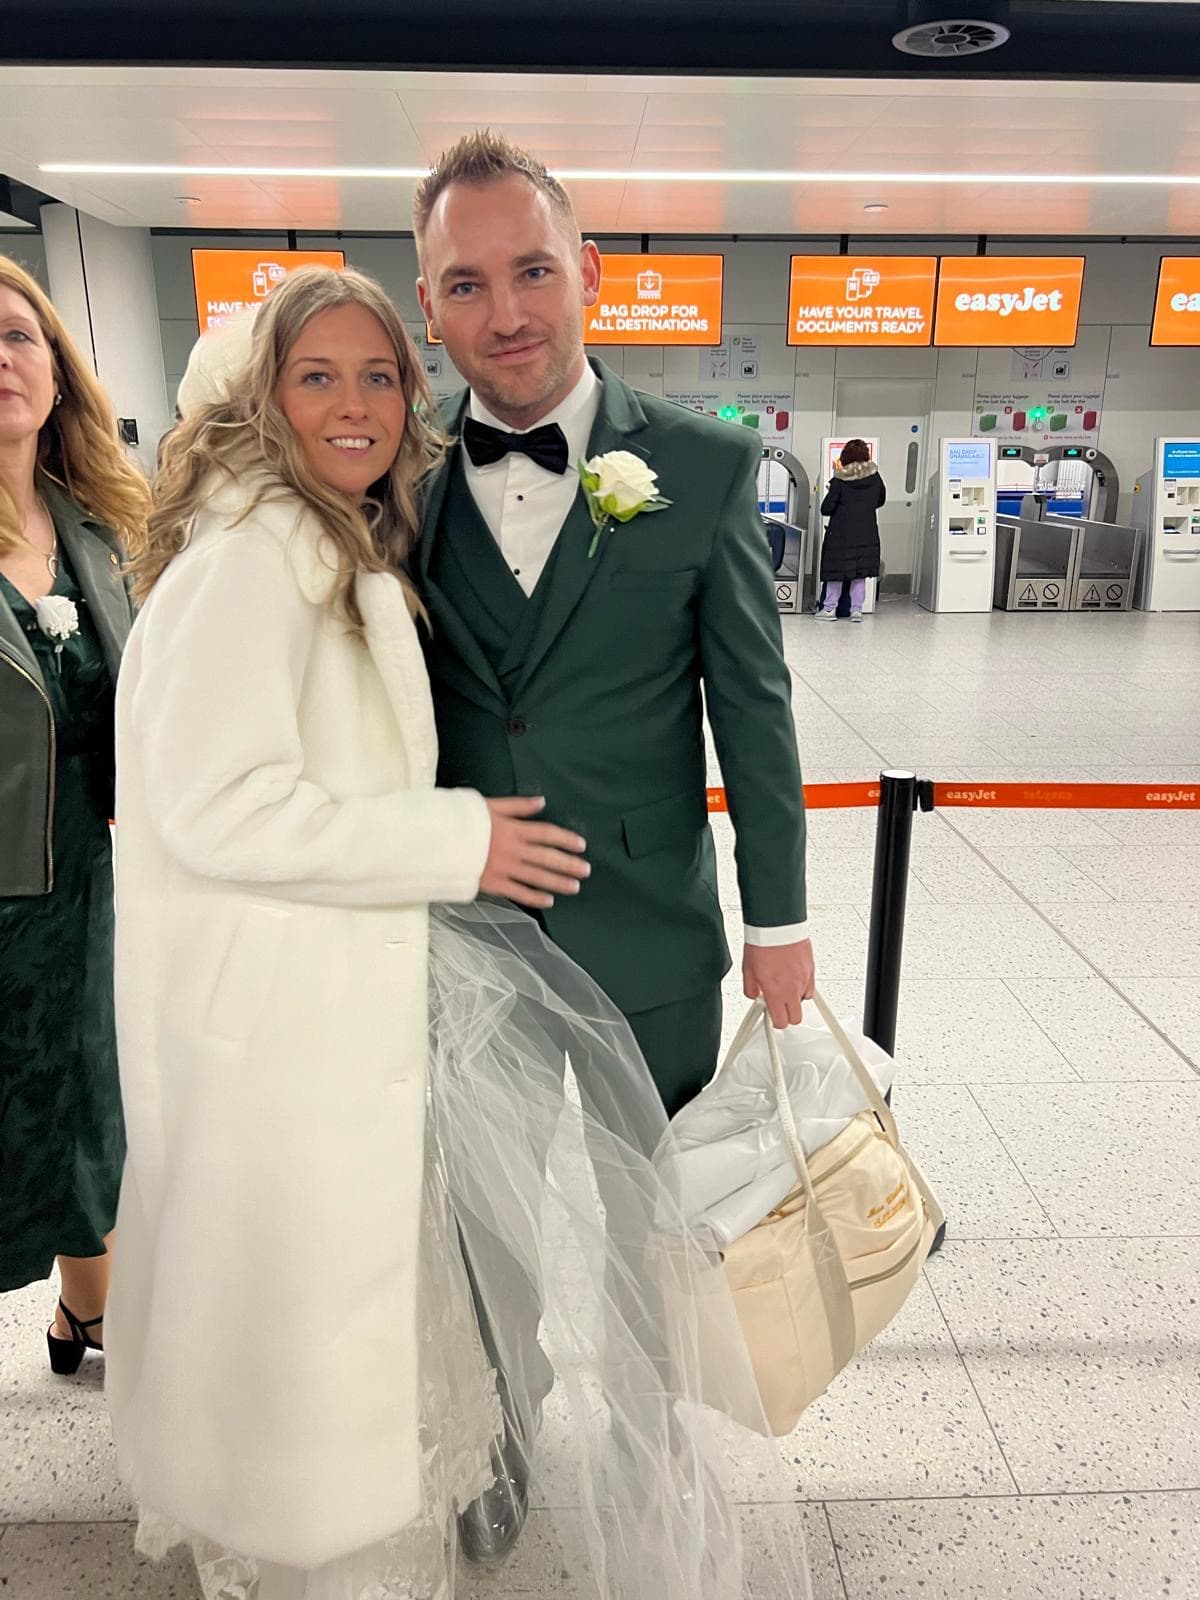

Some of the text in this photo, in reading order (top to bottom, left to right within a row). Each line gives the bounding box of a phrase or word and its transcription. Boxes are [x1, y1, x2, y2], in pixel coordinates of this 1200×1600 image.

[207, 301, 243, 313] HAVE
[954, 288, 1062, 316] easyJet
[600, 305, 698, 317] BAG DROP FOR
[799, 306, 923, 319] HAVE YOUR TRAVEL
[589, 319, 708, 331] ALL DESTINATIONS
[796, 321, 925, 333] DOCUMENTS READY
[946, 789, 997, 801] easyJet
[1145, 790, 1196, 803] easyJet
